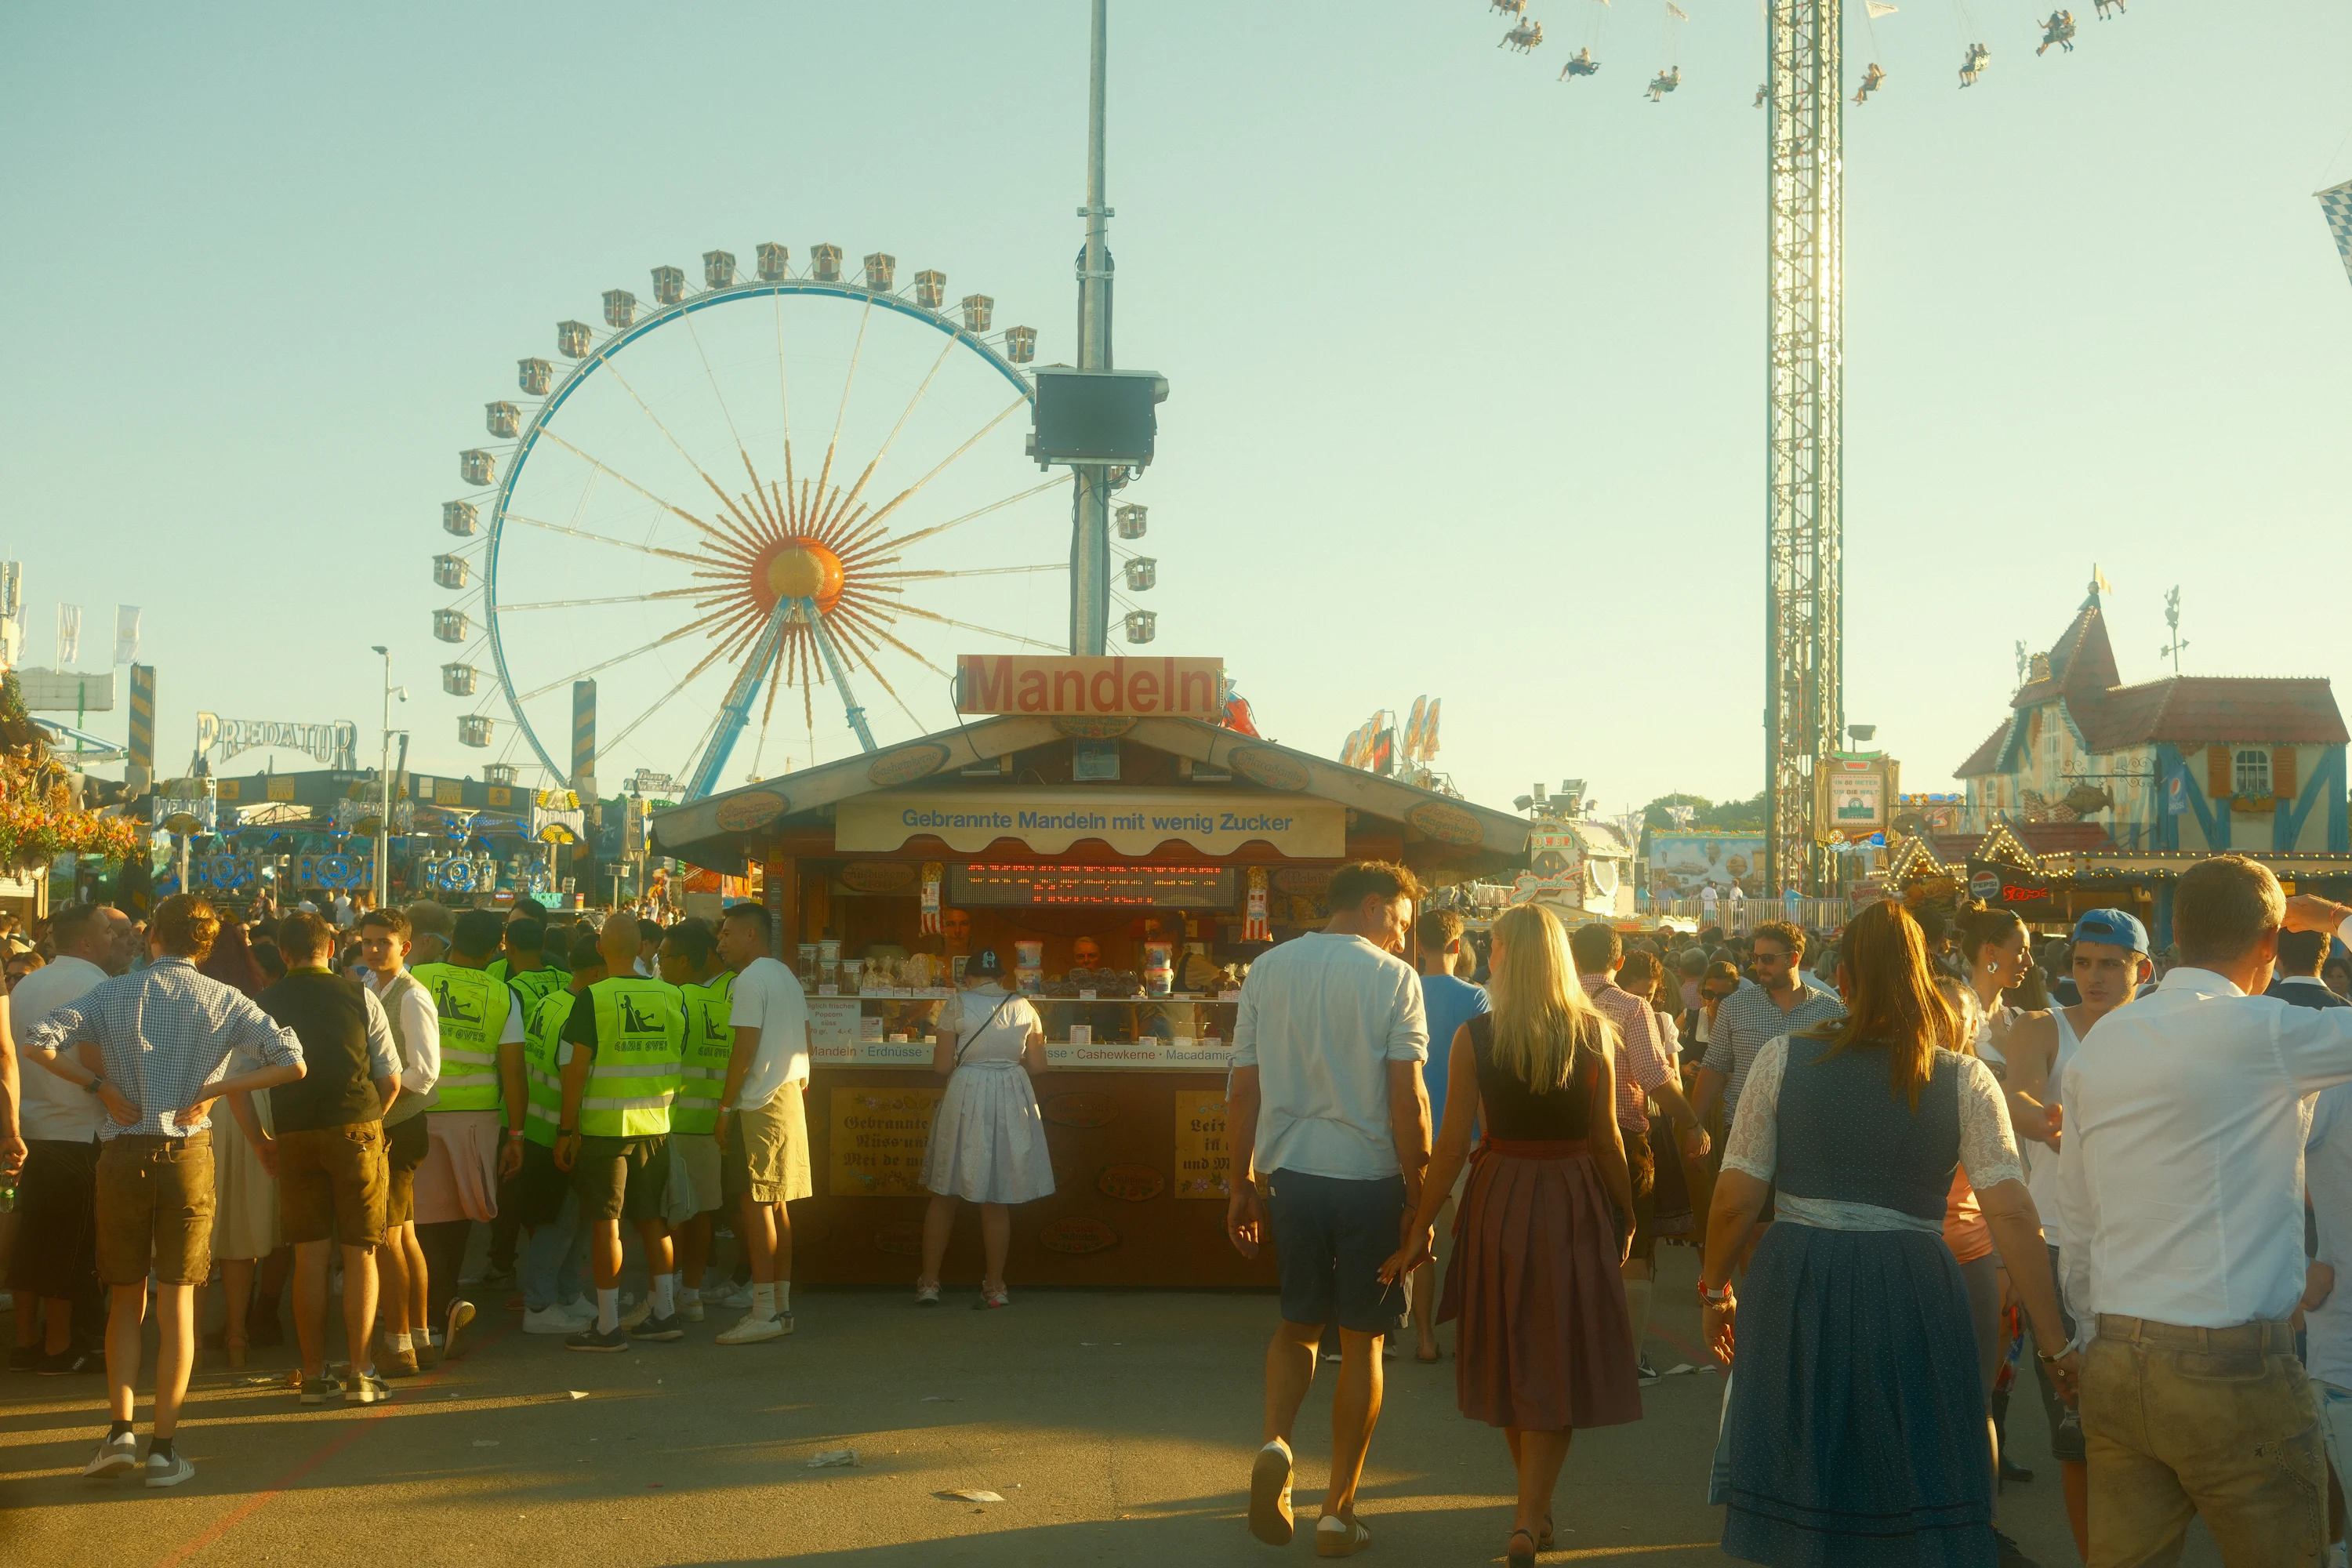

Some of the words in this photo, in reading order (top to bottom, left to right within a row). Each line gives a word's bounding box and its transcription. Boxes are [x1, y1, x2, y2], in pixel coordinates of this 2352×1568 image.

[967, 655, 1212, 713] Mandeln
[197, 711, 358, 771] PREDATOR
[873, 751, 938, 778] Cashewkerne
[1240, 751, 1302, 782] Macadamia
[153, 797, 212, 827] PREDATOR
[1429, 803, 1475, 824] Popcorn
[533, 807, 586, 841] PREDATOR
[902, 809, 1012, 828] Gebrannte
[1018, 811, 1106, 829] Mandeln
[1112, 813, 1145, 830] mit
[1152, 814, 1213, 834] wenig
[1220, 814, 1293, 831] Zucker
[1532, 836, 1571, 847] OWER
[456, 1029, 487, 1043] OVER
[614, 1040, 643, 1051] GAME
[868, 1046, 922, 1057] Erdnüsse
[1077, 1049, 1156, 1059] Cashewkerne
[844, 1116, 929, 1130] Gebrannte
[855, 1134, 900, 1148] Nüss
[1205, 1138, 1220, 1151] in
[843, 1152, 877, 1167] Mei
[883, 1153, 899, 1167] de
[1183, 1156, 1209, 1171] und
